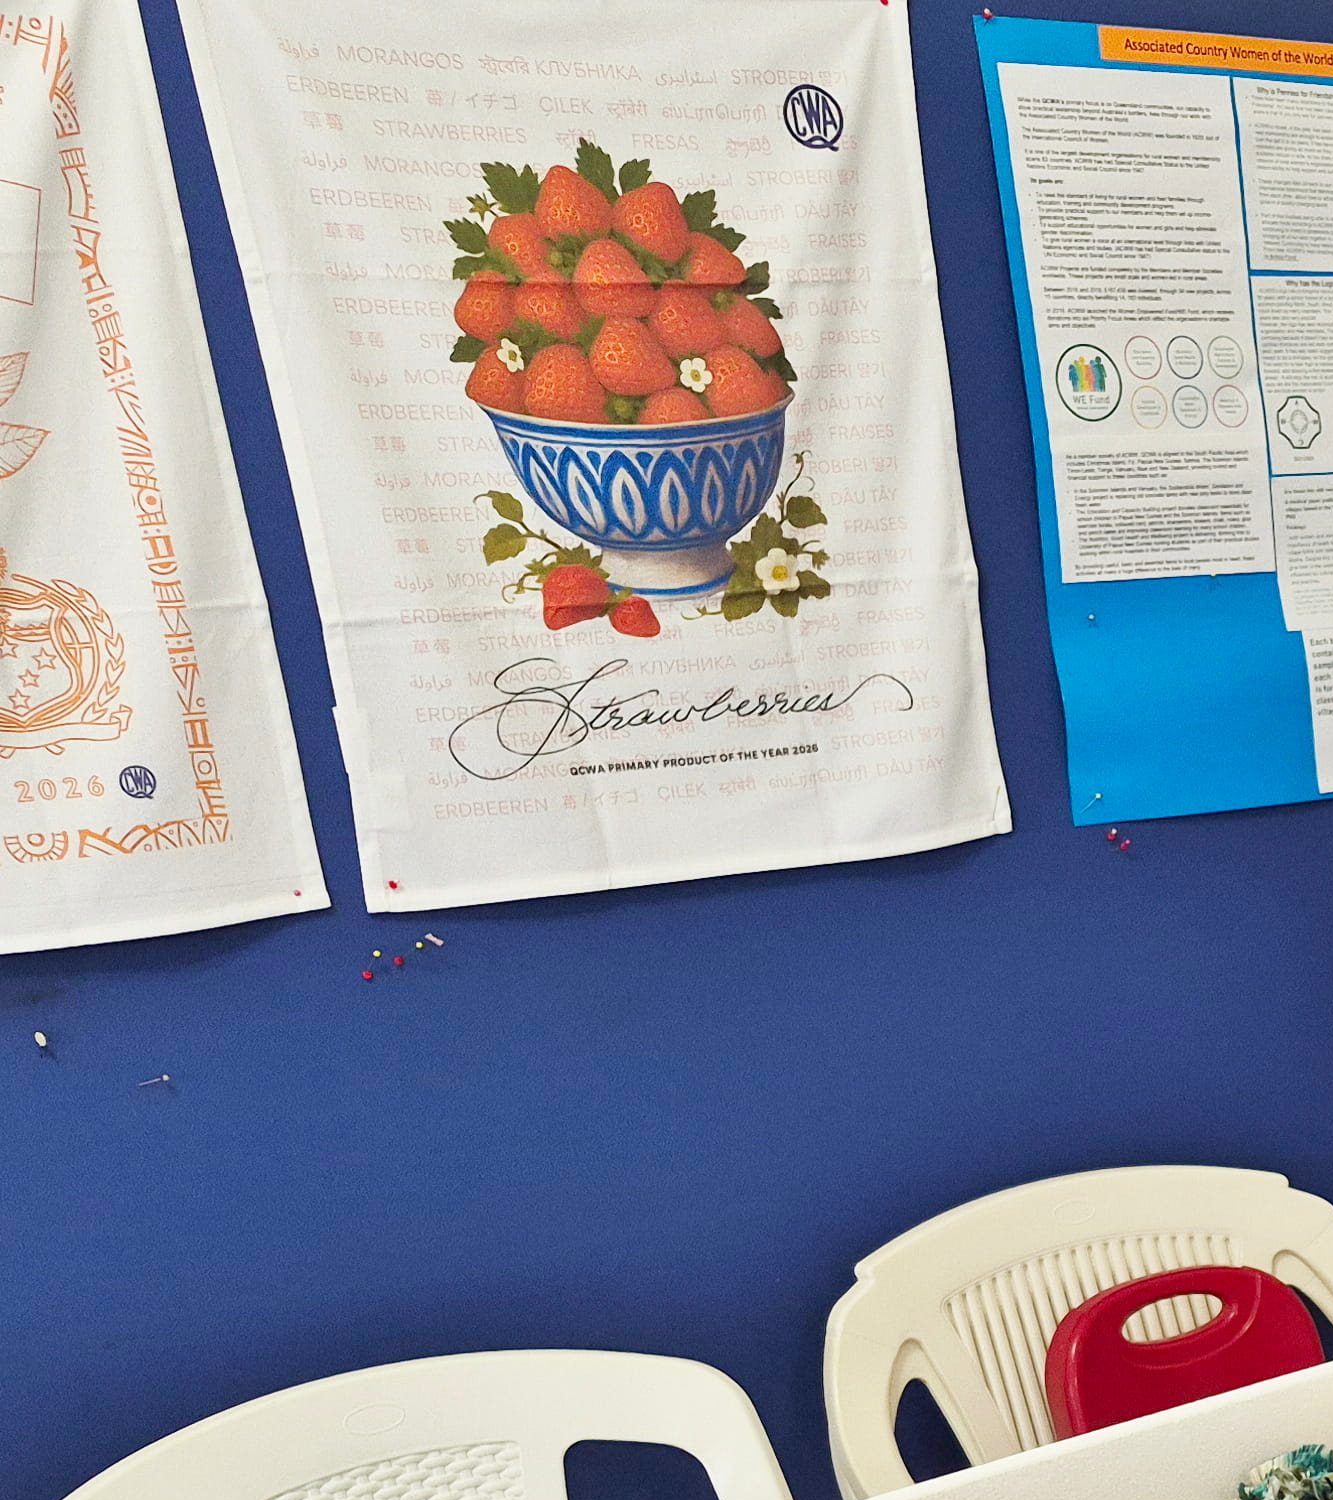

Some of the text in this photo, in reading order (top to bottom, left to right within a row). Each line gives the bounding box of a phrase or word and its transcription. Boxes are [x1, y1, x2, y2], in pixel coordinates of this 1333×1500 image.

[336, 45, 464, 71] MORANGOS
[1124, 37, 1184, 55] Associated
[1186, 42, 1228, 60] Country
[1230, 46, 1270, 62] Women
[1272, 50, 1282, 62] of
[1285, 51, 1301, 63] the
[535, 58, 642, 82] КЛУБНИКА
[731, 68, 814, 86] STROBERI
[286, 73, 409, 105] ERDBEEREN
[371, 119, 528, 145] STRAWBERRIES
[631, 131, 700, 152] FRESAS
[362, 154, 484, 179] MORANGOS
[747, 170, 833, 187] STROBERI
[308, 187, 432, 213] ERDBEEREN
[808, 232, 868, 250] FRAISES
[331, 296, 456, 318] ERDBEEREN
[819, 328, 881, 346] FRAISES
[356, 403, 474, 422] ERDBEEREN
[829, 422, 896, 441] FRAISES
[380, 505, 490, 525] ERDBEEREN
[843, 514, 908, 533] FRAISES
[400, 604, 508, 626] ERDBEEREN
[855, 607, 926, 627] FRAISES
[713, 620, 777, 639] FRESAS
[477, 630, 617, 653] STRAWBERRIES
[816, 640, 898, 661] STROBERI
[466, 664, 574, 688] MORANGOS
[639, 655, 737, 675] КЛУБНИКА
[448, 656, 914, 781] Strawberries
[831, 729, 915, 751] STROBERI
[569, 743, 819, 778] QCWA PRIMARY PRODUCT OF THE YEAR 2026
[13, 773, 106, 804] 2026
[433, 797, 550, 822] ERDBEEREN
